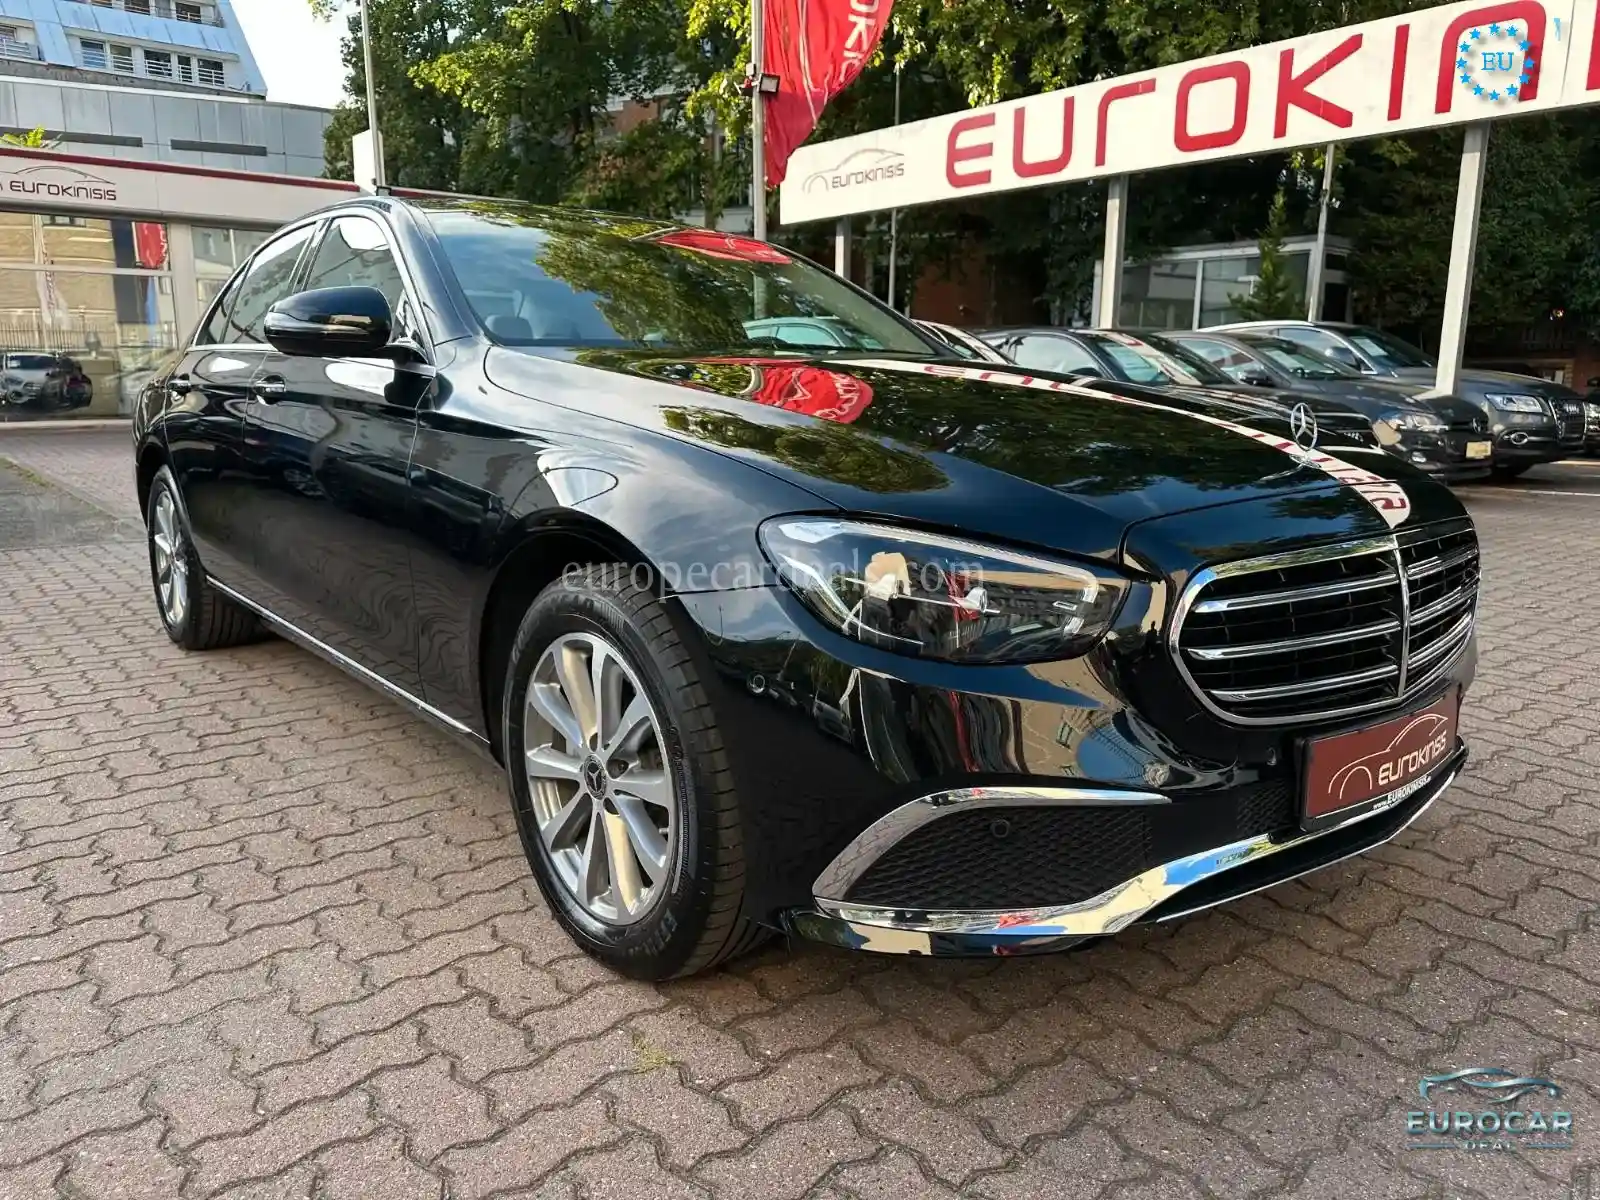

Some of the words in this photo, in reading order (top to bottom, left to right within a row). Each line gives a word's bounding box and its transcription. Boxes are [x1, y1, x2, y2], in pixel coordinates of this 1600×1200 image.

[832, 163, 904, 188] EUROKINISIS
[10, 180, 117, 200] EUROKINISIS
[1378, 730, 1447, 786] EUROKINISIS
